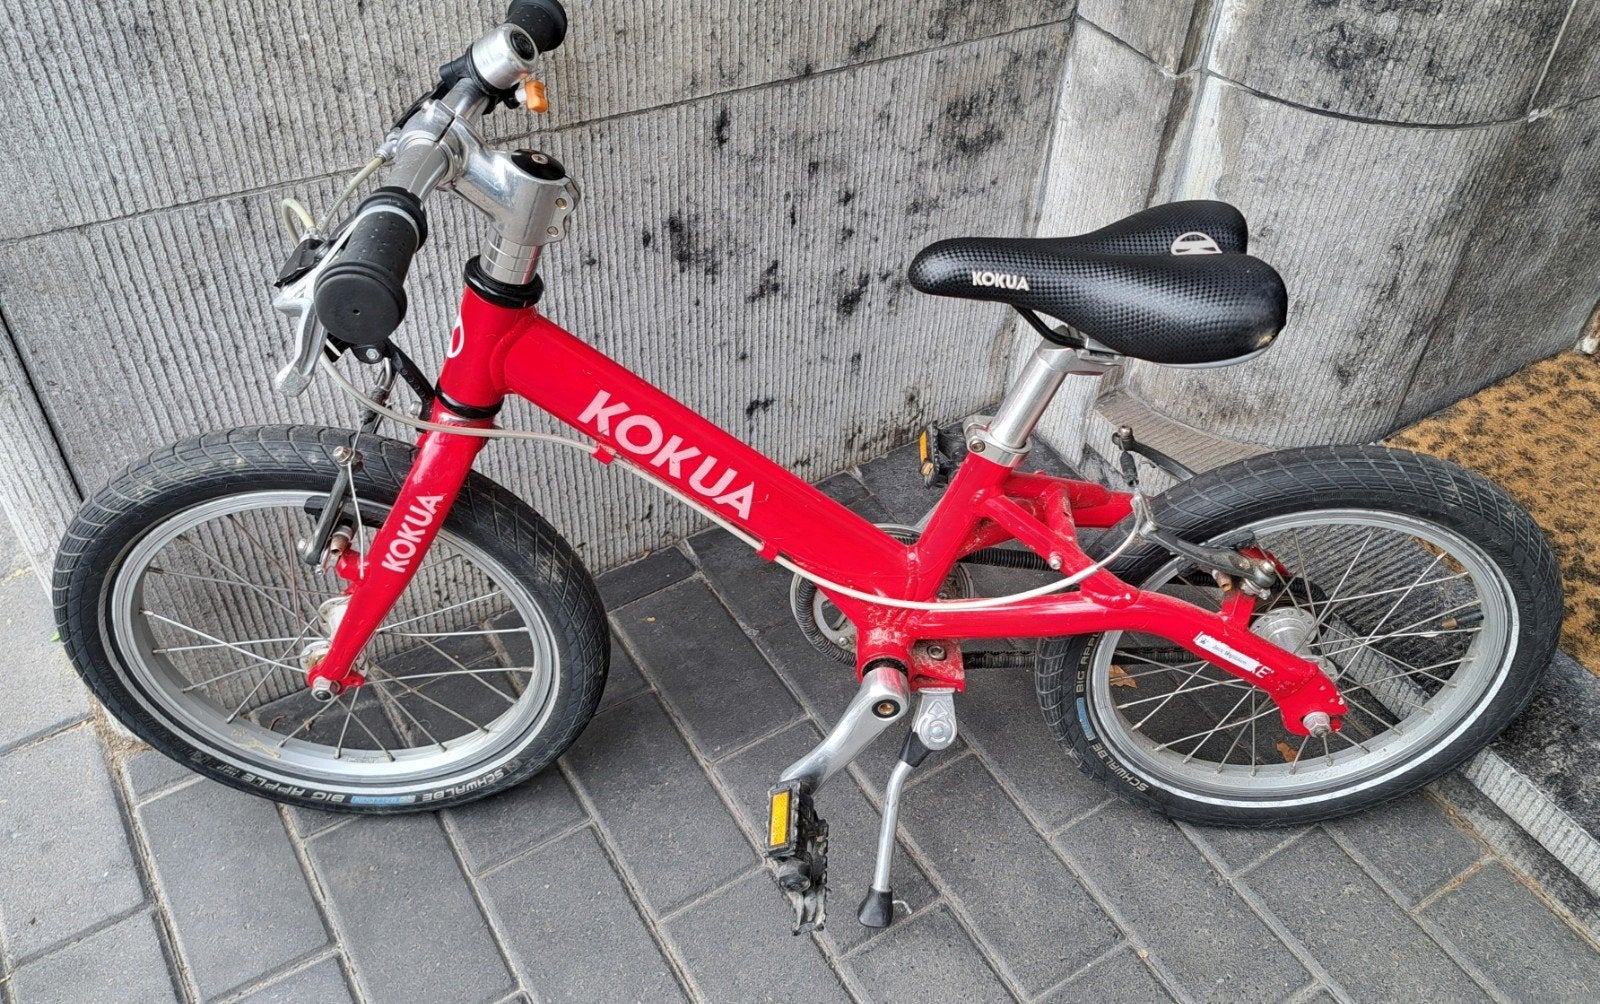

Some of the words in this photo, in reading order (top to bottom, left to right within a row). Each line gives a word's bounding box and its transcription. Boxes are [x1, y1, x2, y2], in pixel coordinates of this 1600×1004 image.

[972, 270, 1029, 291] KOKUA
[578, 389, 755, 521] KOKUA
[381, 493, 444, 573] KOKUA
[1075, 670, 1085, 693] BIG
[1081, 633, 1100, 669] APPL
[241, 772, 306, 796] APPLE
[422, 768, 504, 802] SCHWALBE
[1091, 743, 1149, 792] SCHWALBE
[311, 791, 346, 803] BIG
